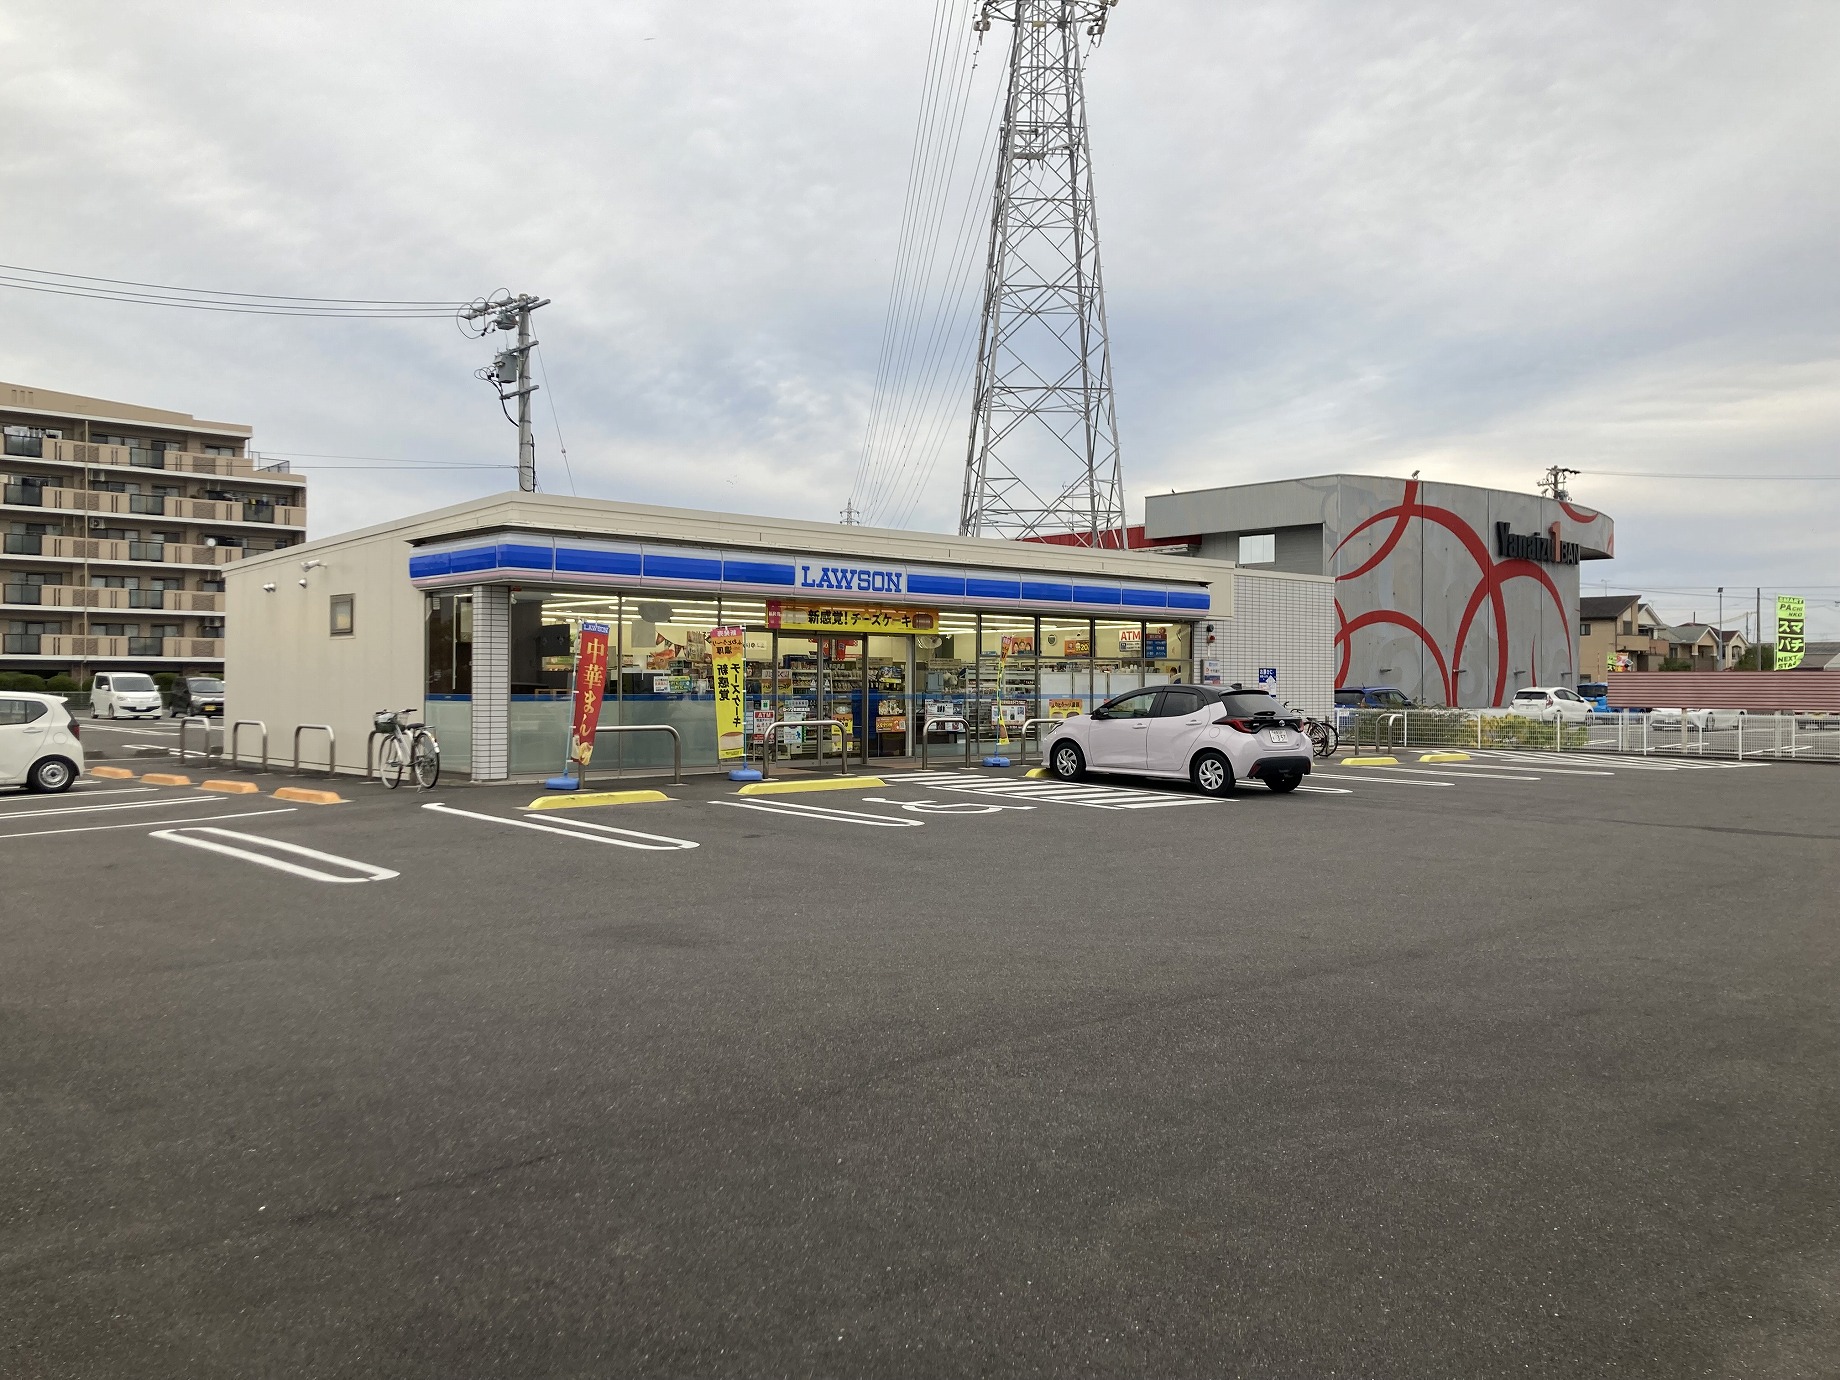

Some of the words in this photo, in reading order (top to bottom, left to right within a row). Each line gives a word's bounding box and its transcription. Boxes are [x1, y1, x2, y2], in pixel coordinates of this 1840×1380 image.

[801, 565, 902, 593] LAWSON
[1779, 621, 1804, 633] スマ
[1121, 630, 1141, 641] ATM
[1779, 638, 1804, 652] パチ
[581, 638, 605, 737] 中華まん
